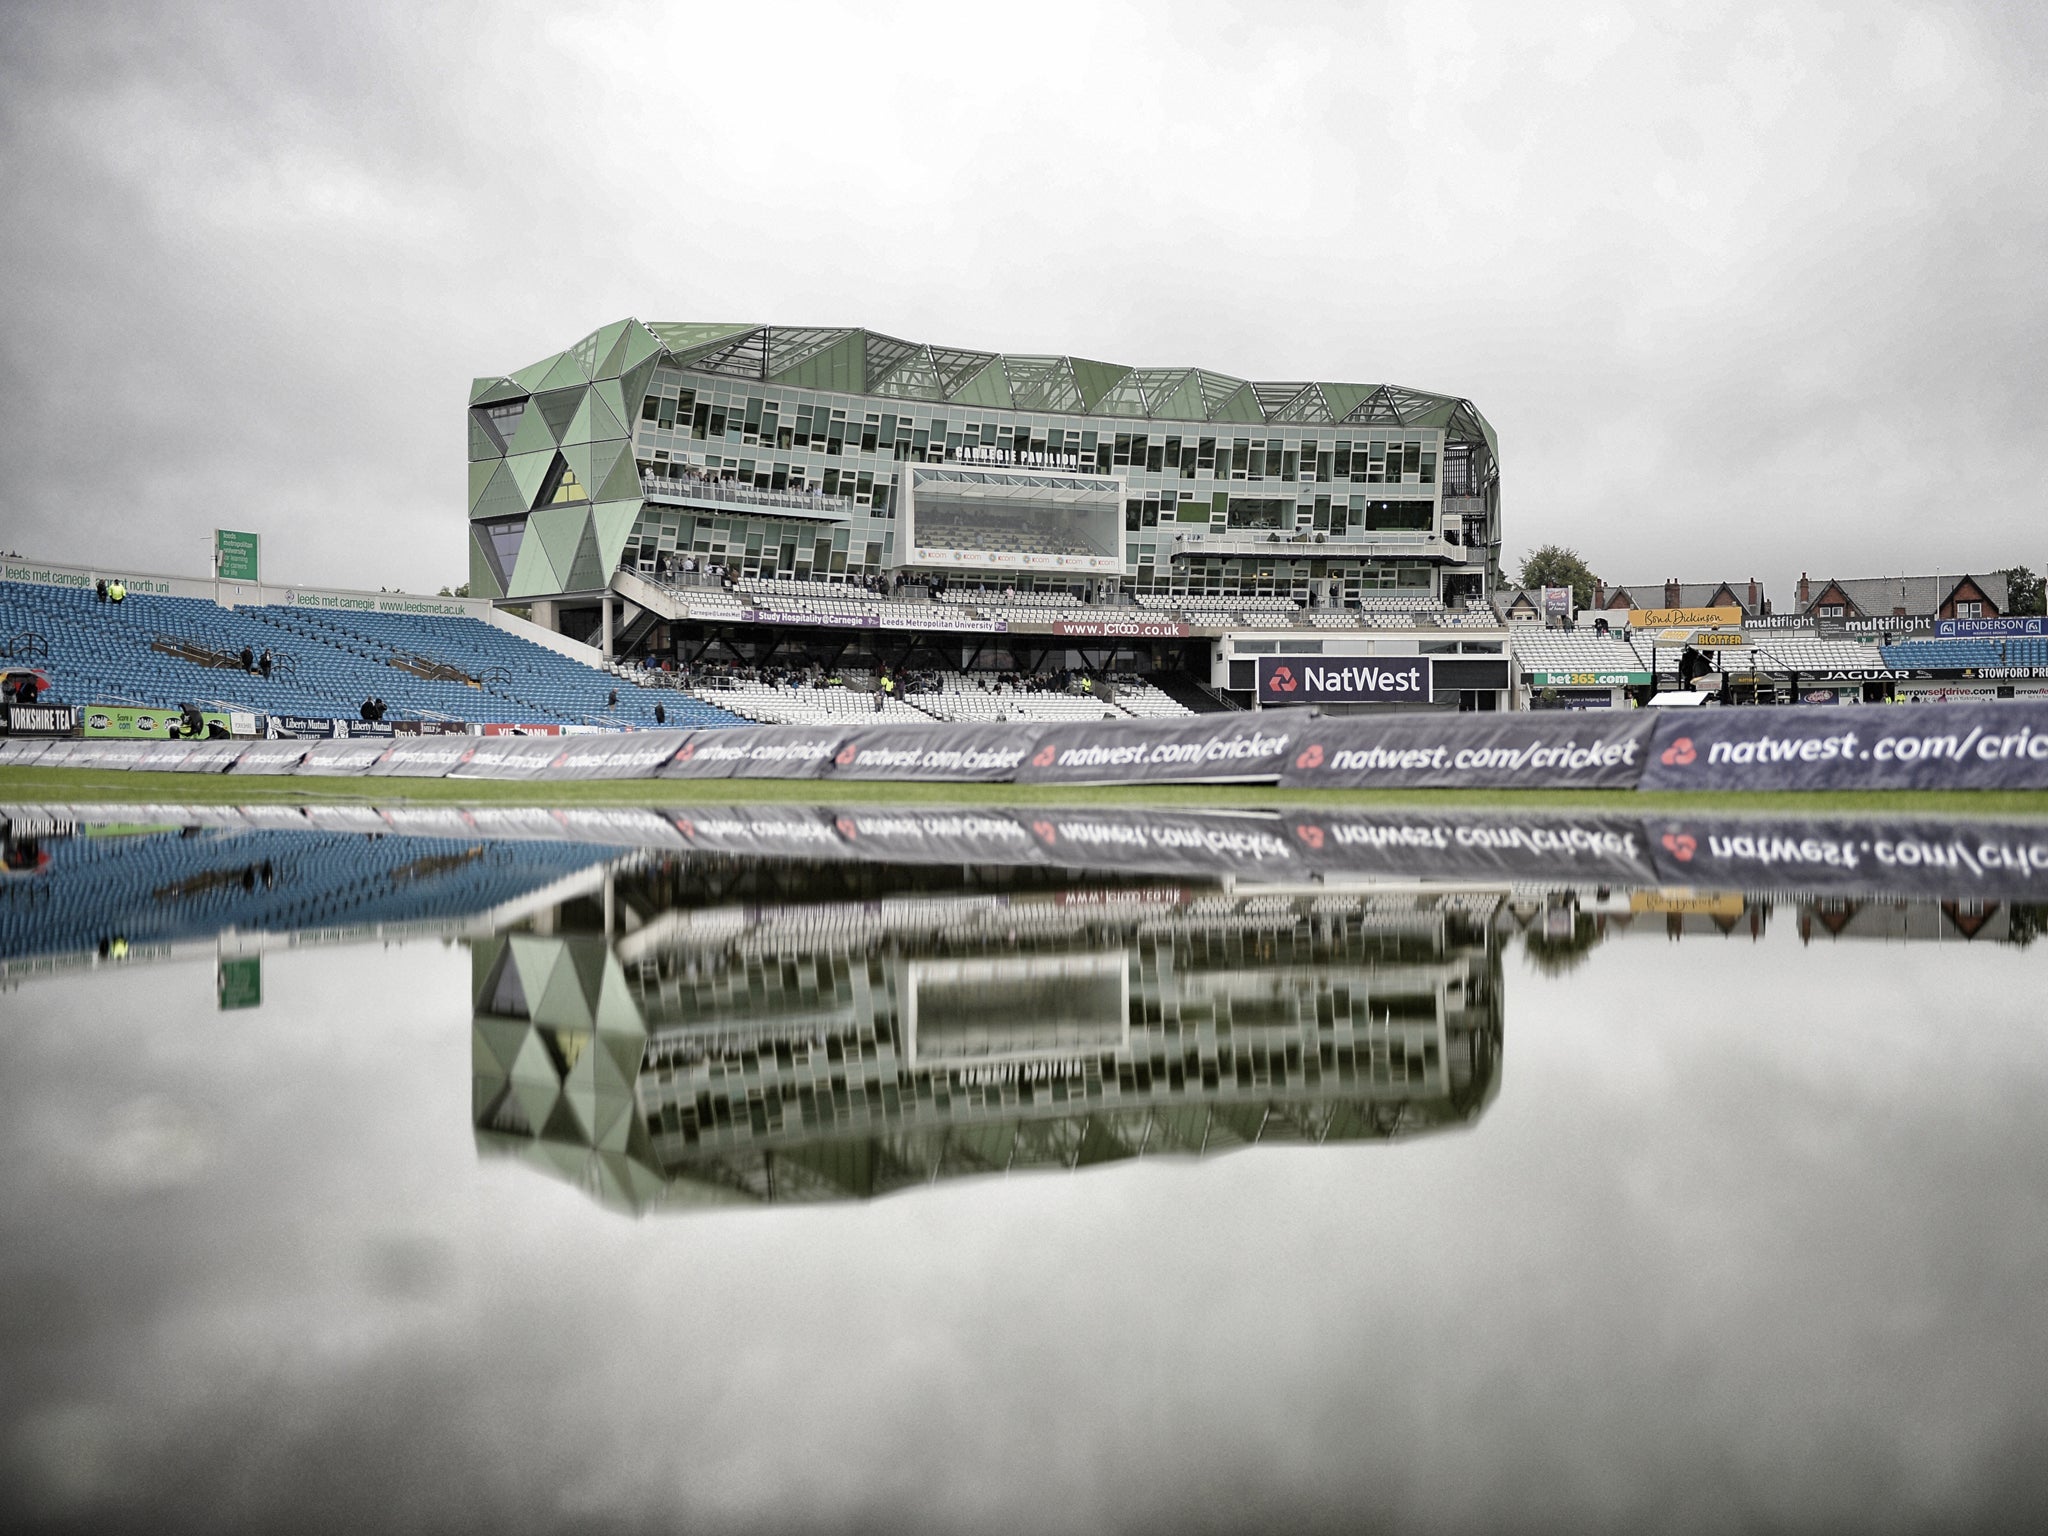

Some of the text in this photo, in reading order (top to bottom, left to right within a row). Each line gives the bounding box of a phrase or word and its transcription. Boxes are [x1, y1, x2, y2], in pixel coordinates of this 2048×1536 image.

[955, 446, 1077, 466] CARNEGIE PAVILION
[5, 565, 91, 589] leeds met carnegie
[130, 579, 153, 592] north
[156, 581, 170, 593] uni
[297, 593, 466, 616] leeds met carnegie www.leedsmet.ac.uk
[758, 611, 780, 622] Study
[881, 618, 993, 631] Leeds Metropolitan University
[1644, 609, 1724, 626] Bond Dickinson
[1745, 615, 1815, 629] multiflight
[1845, 616, 1931, 633] multiflight
[1063, 622, 1180, 636] www.JCT600.co.uk
[1957, 619, 2024, 631] HENDERSON
[1698, 634, 1742, 645] BLOTTER
[1304, 667, 1420, 692] NatWest
[1547, 673, 1629, 685] bet365.com
[1819, 670, 1910, 680] JAGUAR
[1978, 668, 2030, 679] STOWFORD
[10, 707, 71, 731] YORKSHIRE TEA
[285, 717, 330, 733] Liberty Mutual
[351, 720, 392, 734] Liberty Mutual
[1057, 731, 1290, 768] natwest.com/cricket
[1707, 726, 2048, 765] natwest.com/cric
[856, 744, 1025, 770] natwest.com/cricket
[1330, 738, 1640, 771] natwest.com/cricket
